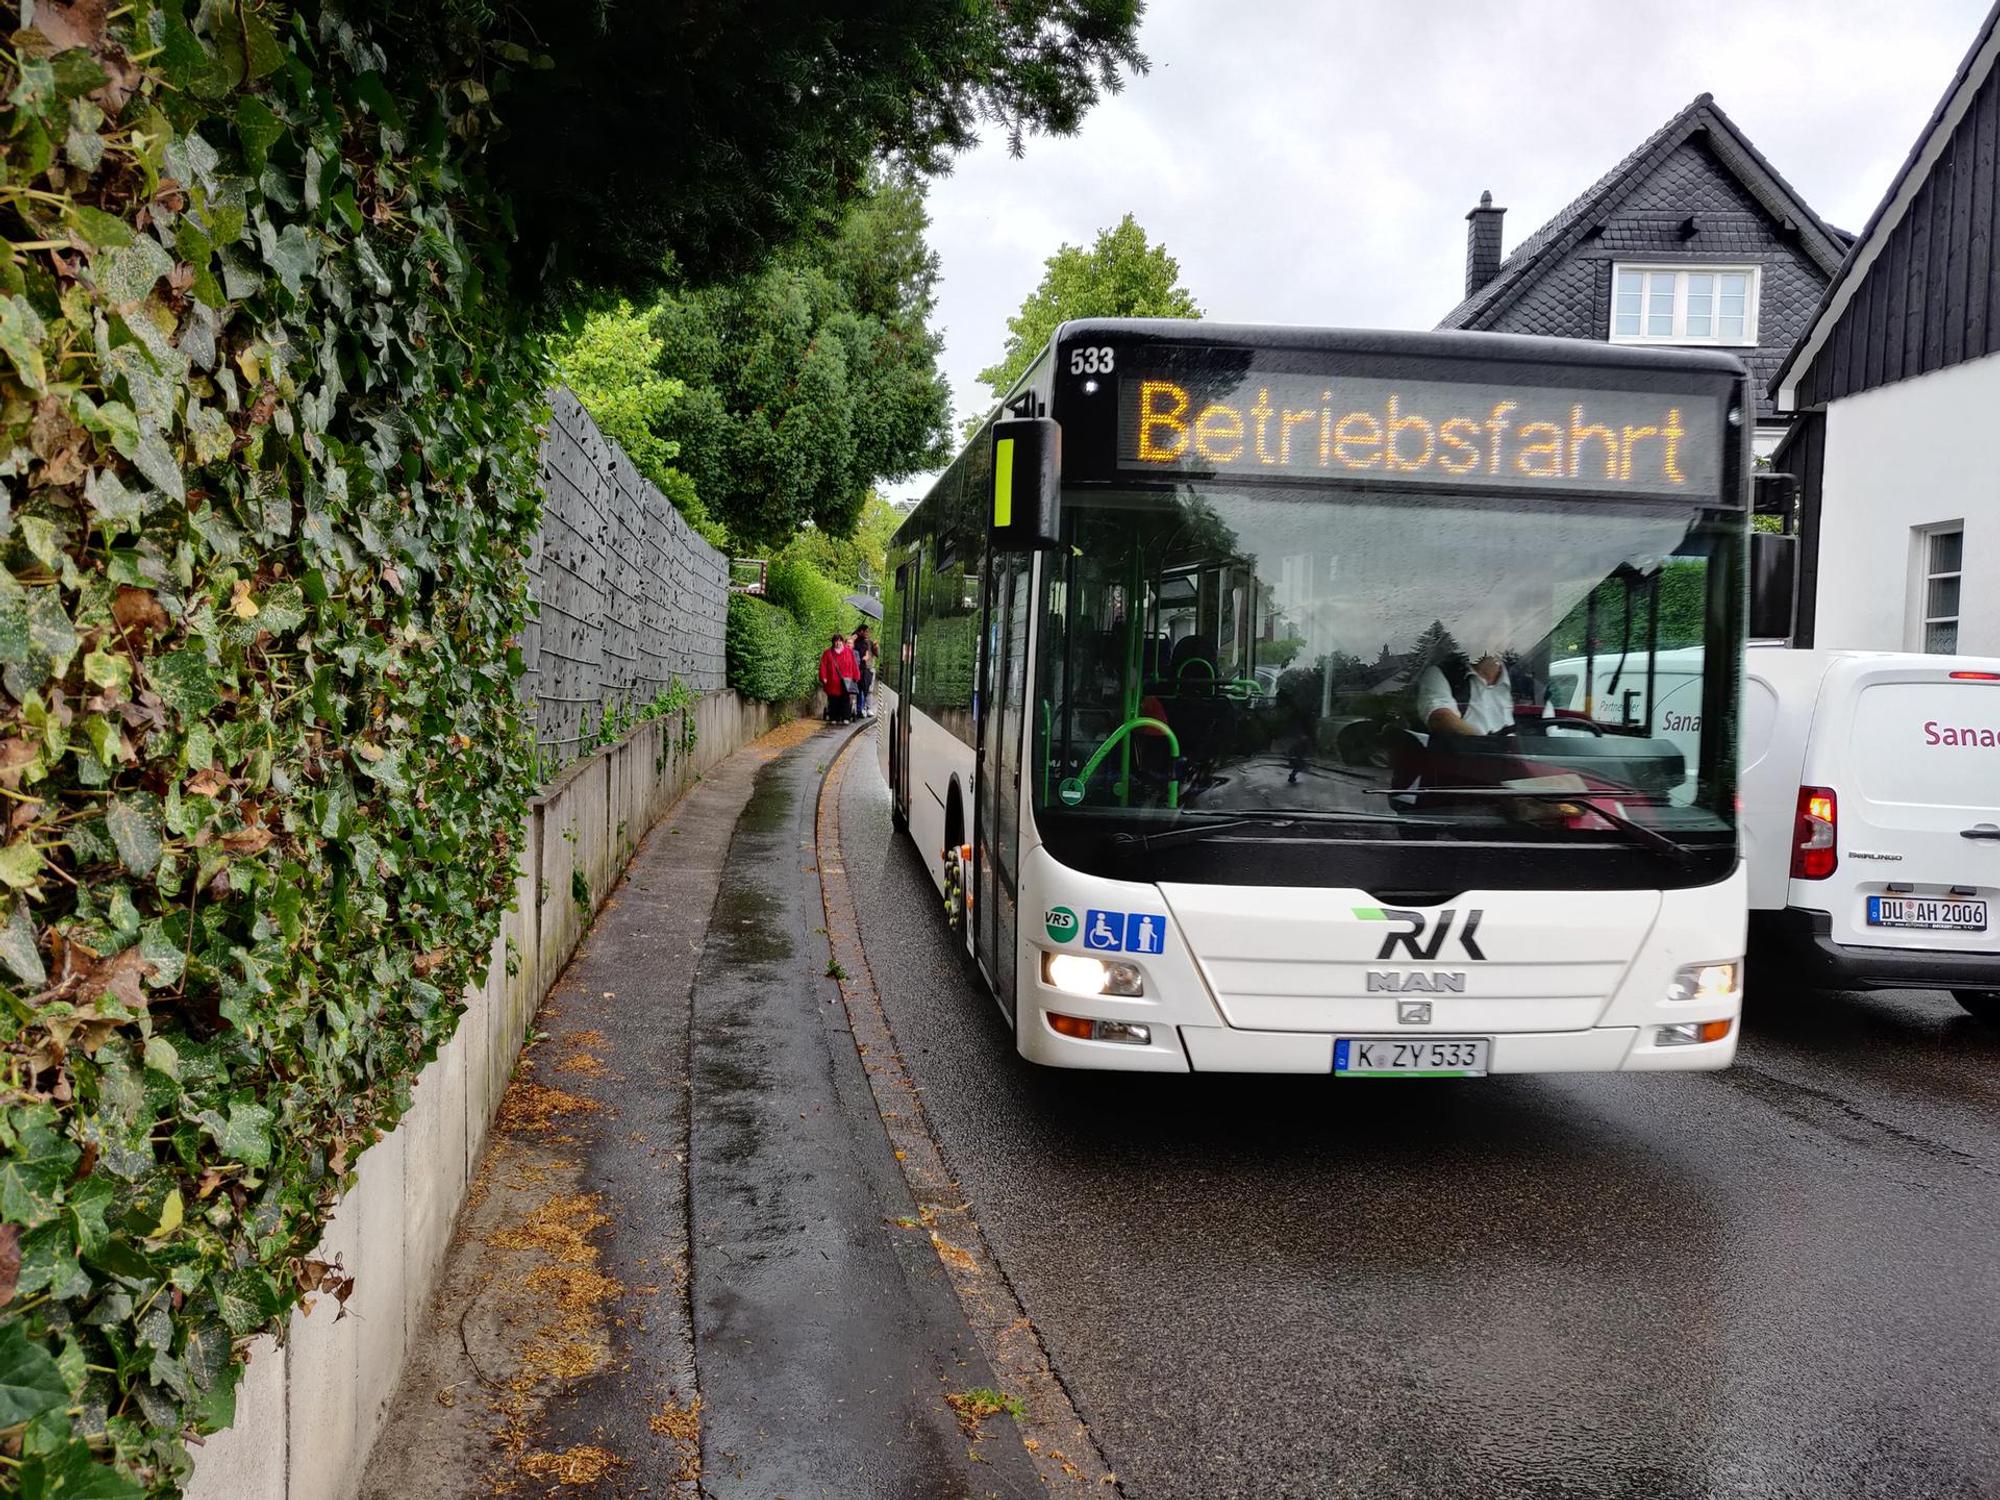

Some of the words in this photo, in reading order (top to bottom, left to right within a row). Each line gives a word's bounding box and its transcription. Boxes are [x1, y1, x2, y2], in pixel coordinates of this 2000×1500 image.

[1071, 347, 1114, 375] 533
[1137, 379, 1687, 484] Betriebsfahrt
[1923, 721, 2000, 747] Sana
[1045, 911, 1071, 927] VRS
[1881, 901, 1903, 920] DU
[1916, 903, 1938, 922] AH
[1941, 904, 1983, 923] 2006
[1366, 971, 1467, 993] MAN
[1358, 1044, 1375, 1067] K
[1393, 1044, 1425, 1067] ZY
[1431, 1044, 1477, 1067] 533
